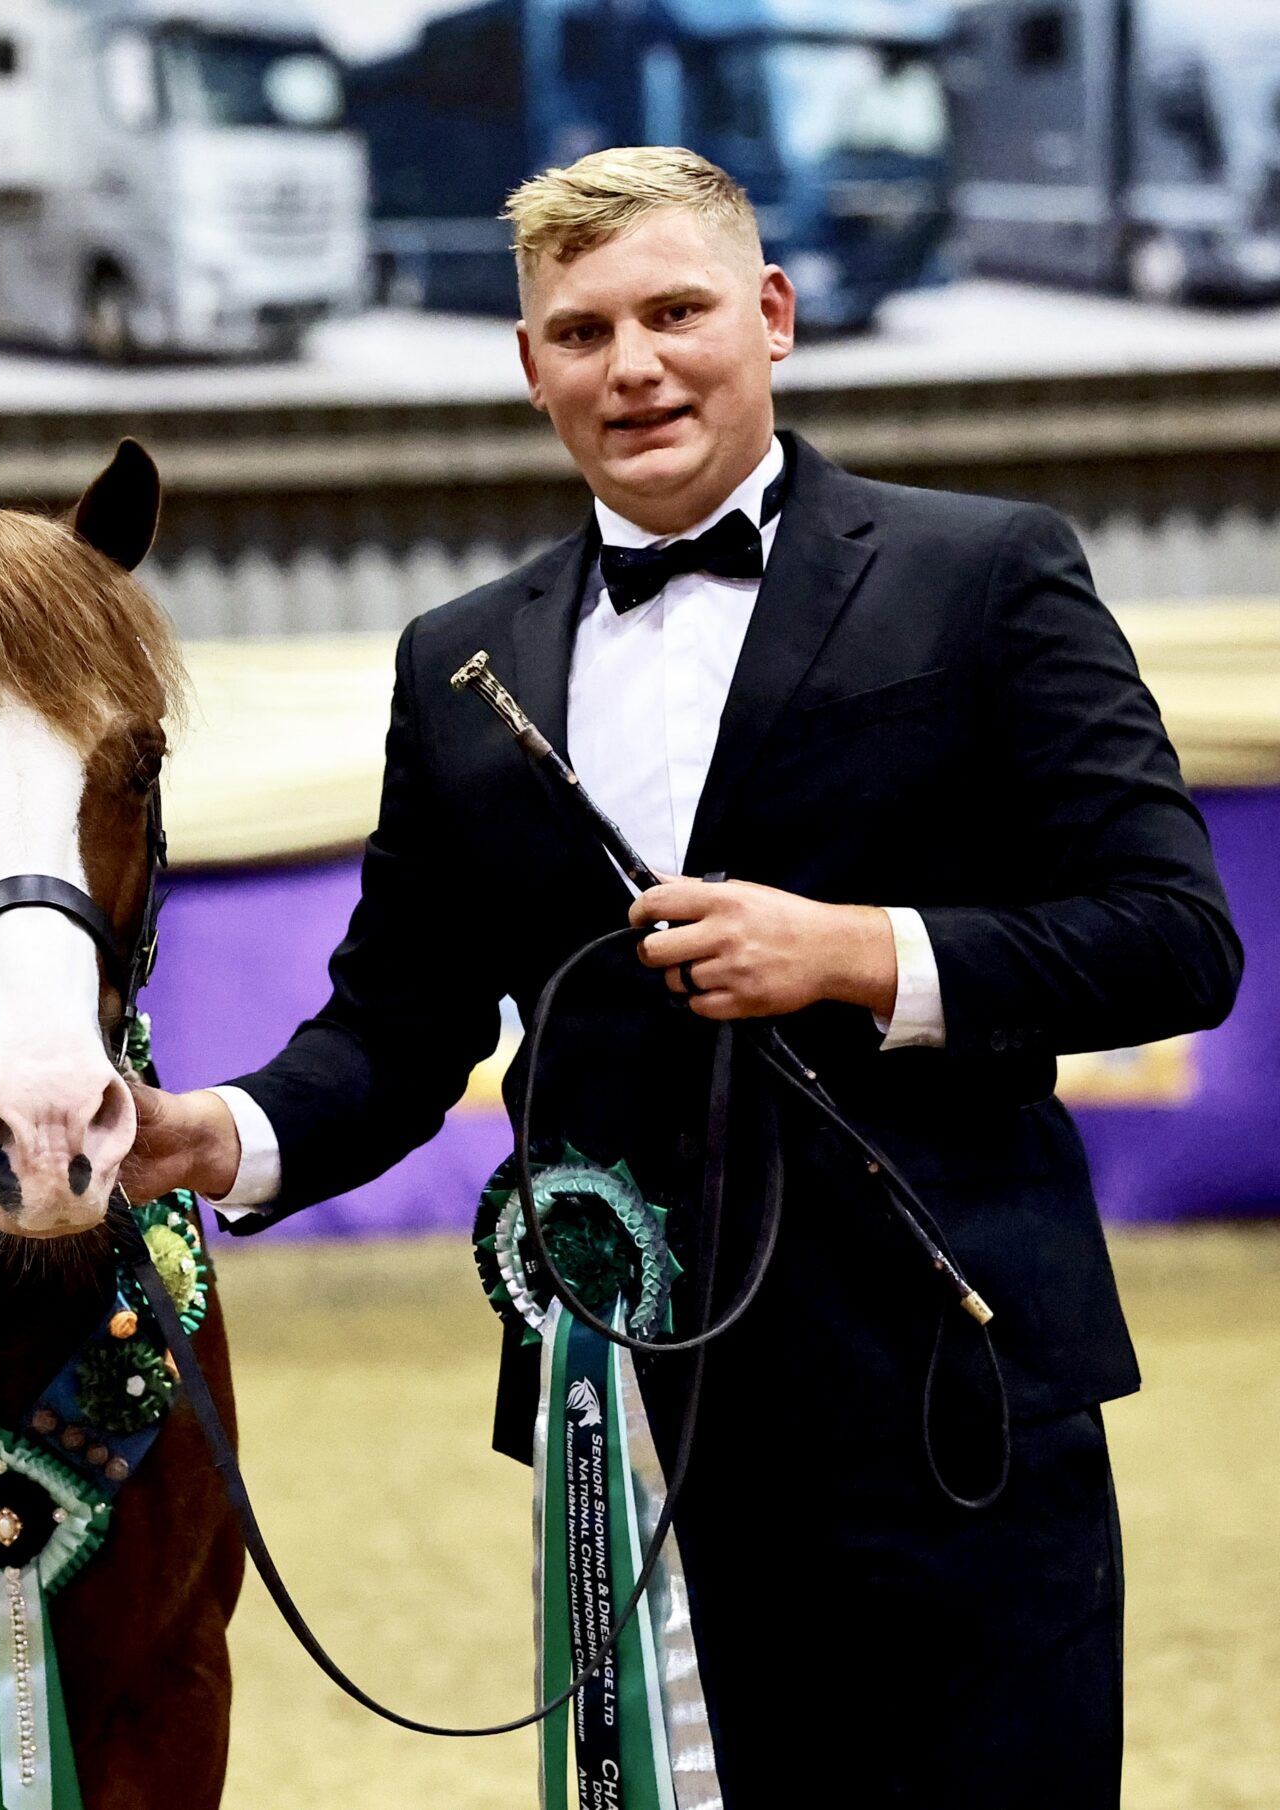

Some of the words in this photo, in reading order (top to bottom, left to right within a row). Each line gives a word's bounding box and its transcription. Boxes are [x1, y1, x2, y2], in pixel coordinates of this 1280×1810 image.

[578, 1456, 590, 1539] NATIONAL
[591, 1433, 603, 1496] SENIOR
[594, 1499, 606, 1579] SHOWING
[566, 1420, 575, 1481] MEMBERS
[575, 1648, 586, 1742] CHAPIONSHIP
[581, 1543, 600, 1678] CHAMPIONSHIS
[597, 1582, 610, 1597] &
[598, 1599, 615, 1691] DRESAGE
